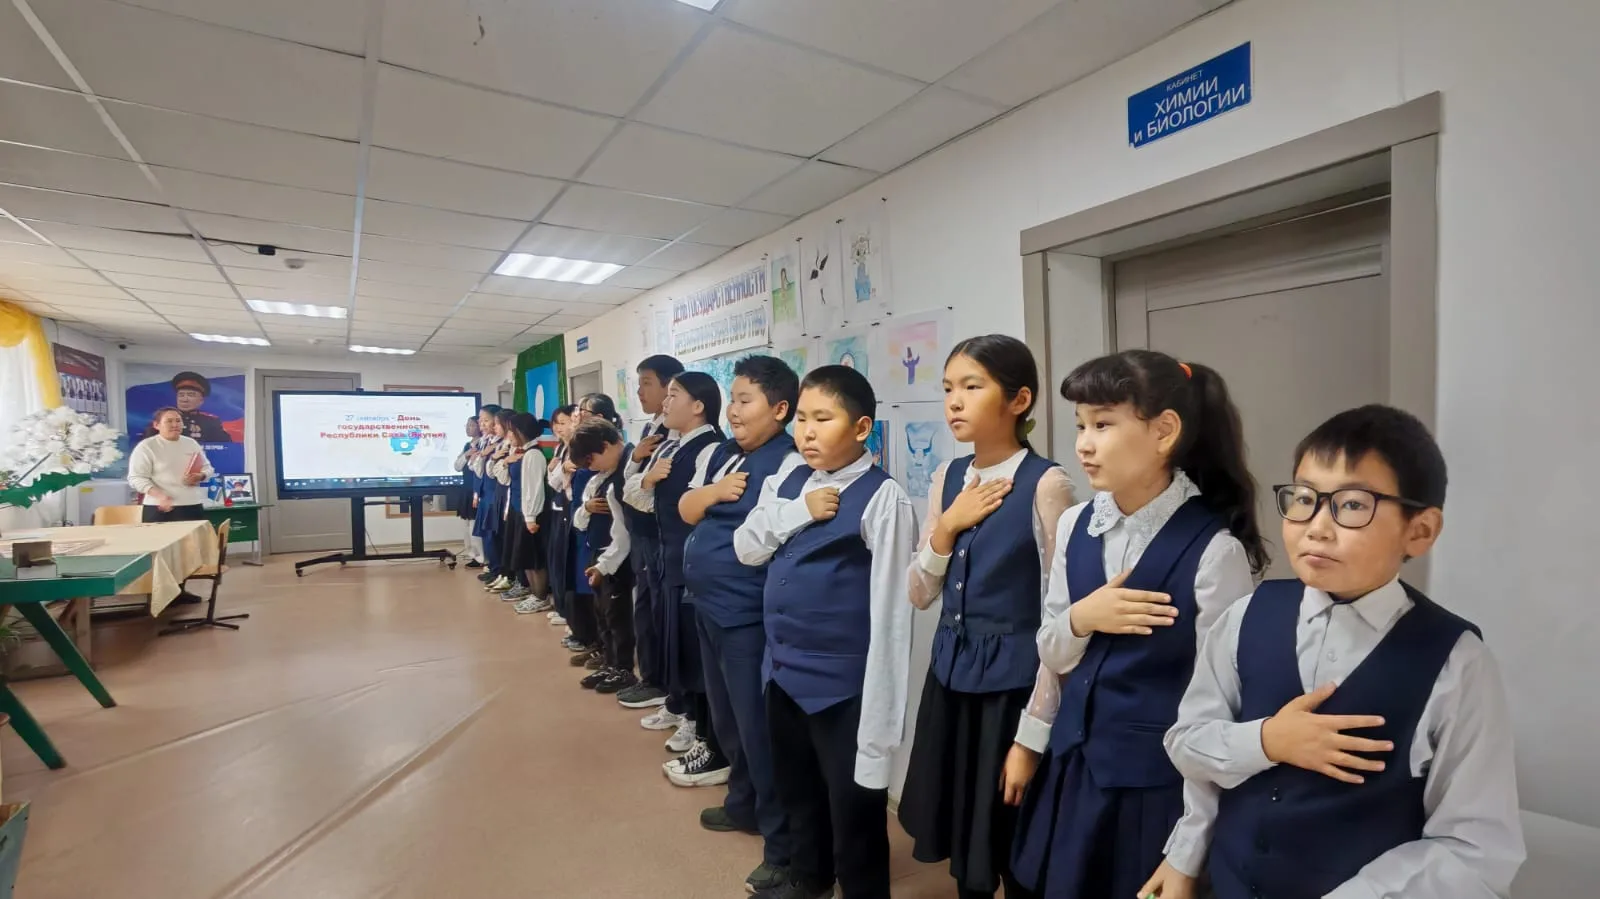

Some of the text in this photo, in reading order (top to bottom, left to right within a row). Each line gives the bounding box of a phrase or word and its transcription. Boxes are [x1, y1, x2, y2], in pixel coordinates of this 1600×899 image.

[1154, 76, 1218, 118] ХИМИИ
[1166, 70, 1203, 92] КАБИНЕТ
[1147, 83, 1245, 138] БИОЛОГИИ
[688, 268, 766, 319] ГОСУДАРСТВЕННОСТИ
[397, 414, 421, 422] День
[320, 431, 379, 439] Республики
[408, 431, 447, 440] (Якутия)
